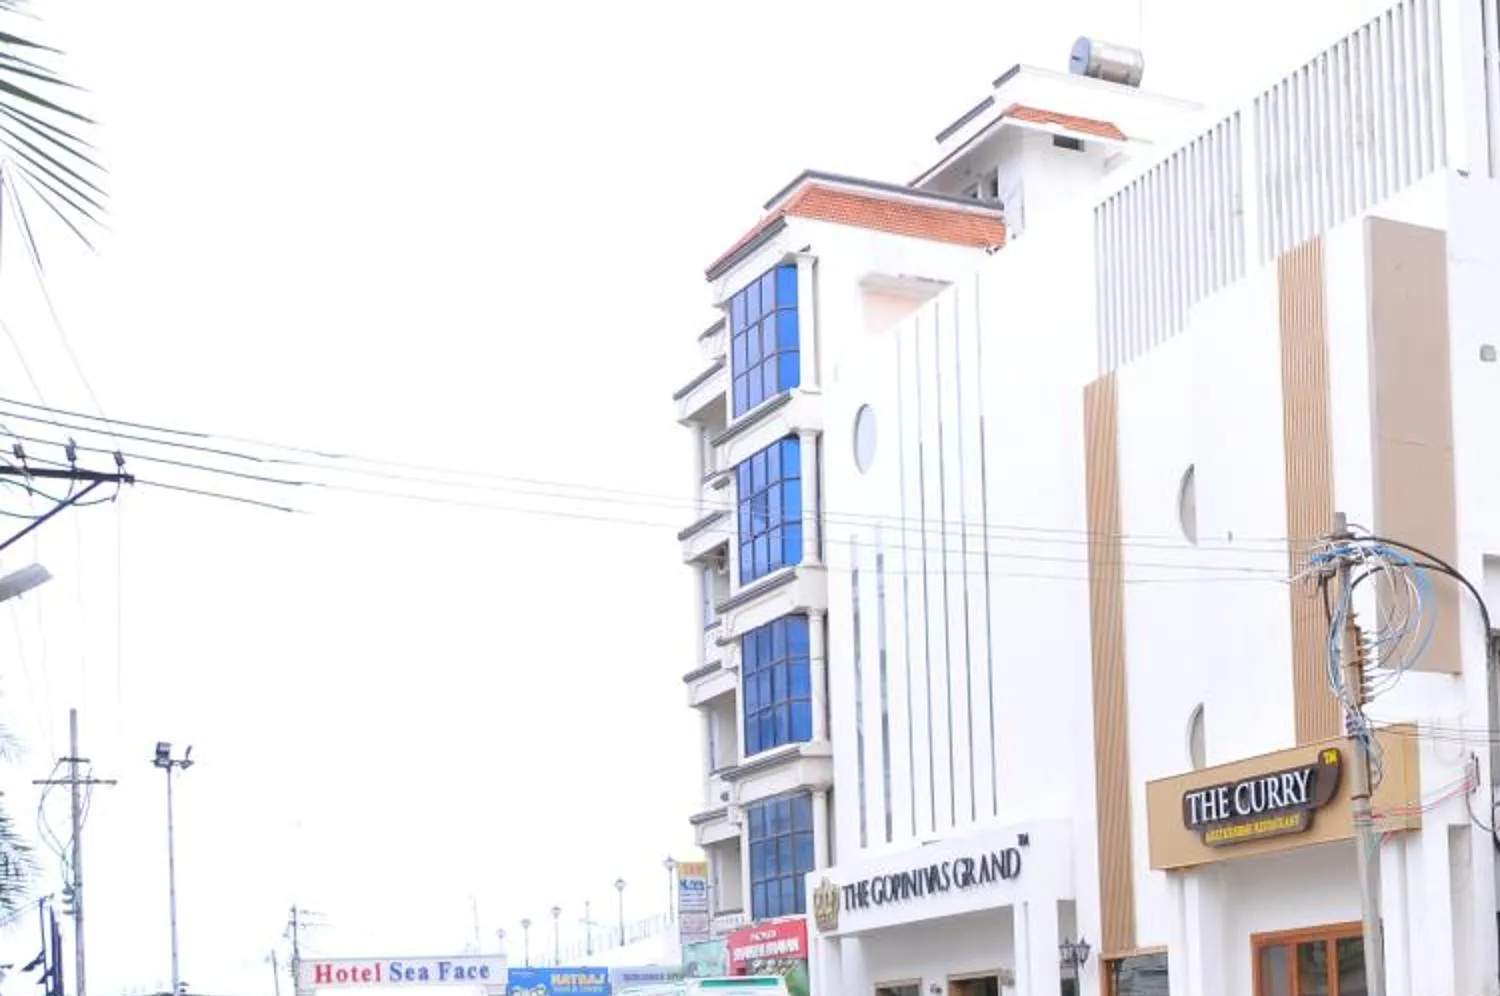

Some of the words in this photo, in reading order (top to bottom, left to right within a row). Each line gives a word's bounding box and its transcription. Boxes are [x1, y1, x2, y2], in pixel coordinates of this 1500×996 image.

[1186, 786, 1229, 824] THE
[1235, 768, 1311, 815] CURRY
[842, 879, 869, 911] THE
[871, 861, 952, 905] GOPINIVAS
[953, 847, 1021, 888] GRAND
[314, 962, 382, 984] Hotel
[389, 962, 430, 982] Sea
[438, 961, 491, 981] Face
